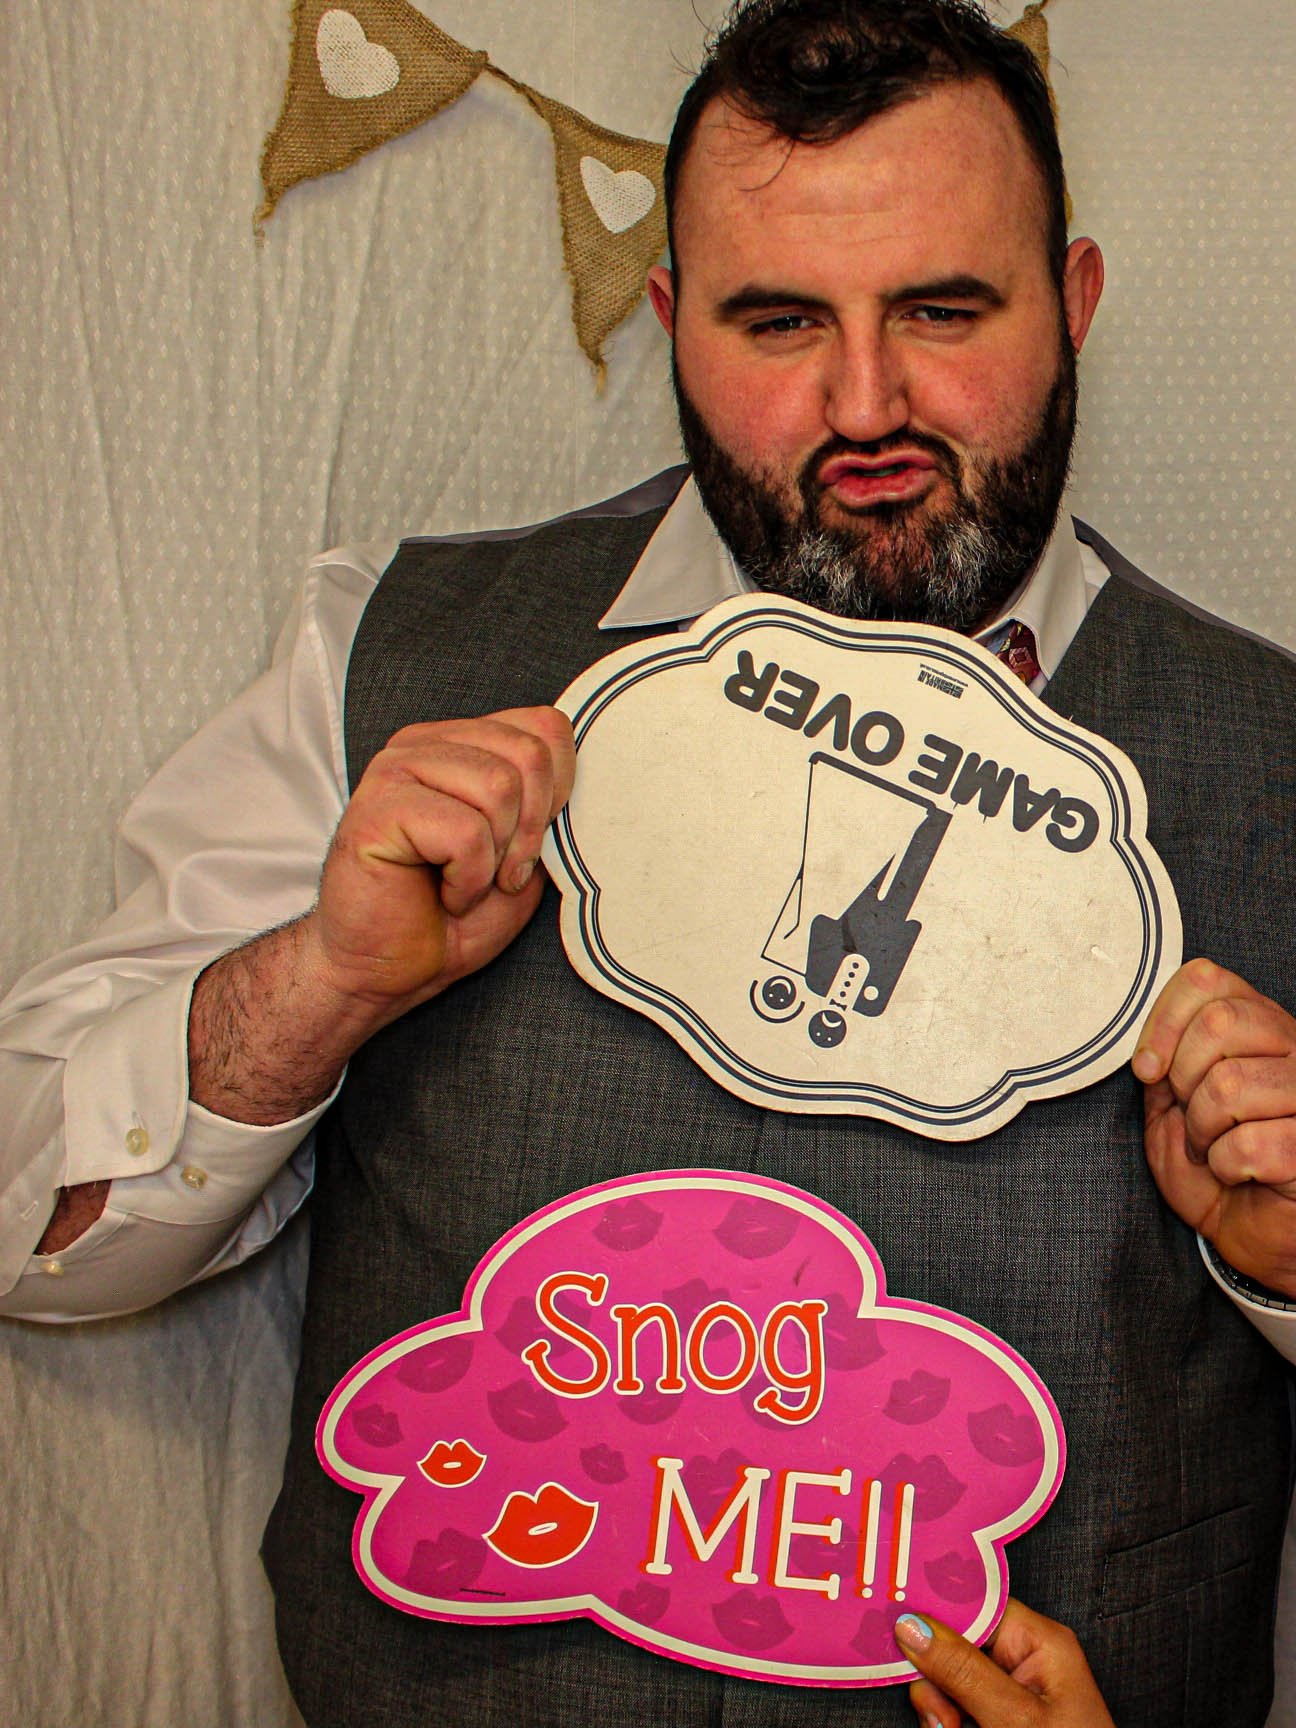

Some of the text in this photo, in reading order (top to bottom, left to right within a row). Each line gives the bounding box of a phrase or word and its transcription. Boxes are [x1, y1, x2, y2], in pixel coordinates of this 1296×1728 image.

[723, 650, 1100, 854] GAME OVER
[522, 1271, 828, 1425] Snog
[638, 1456, 916, 1604] ME!!
